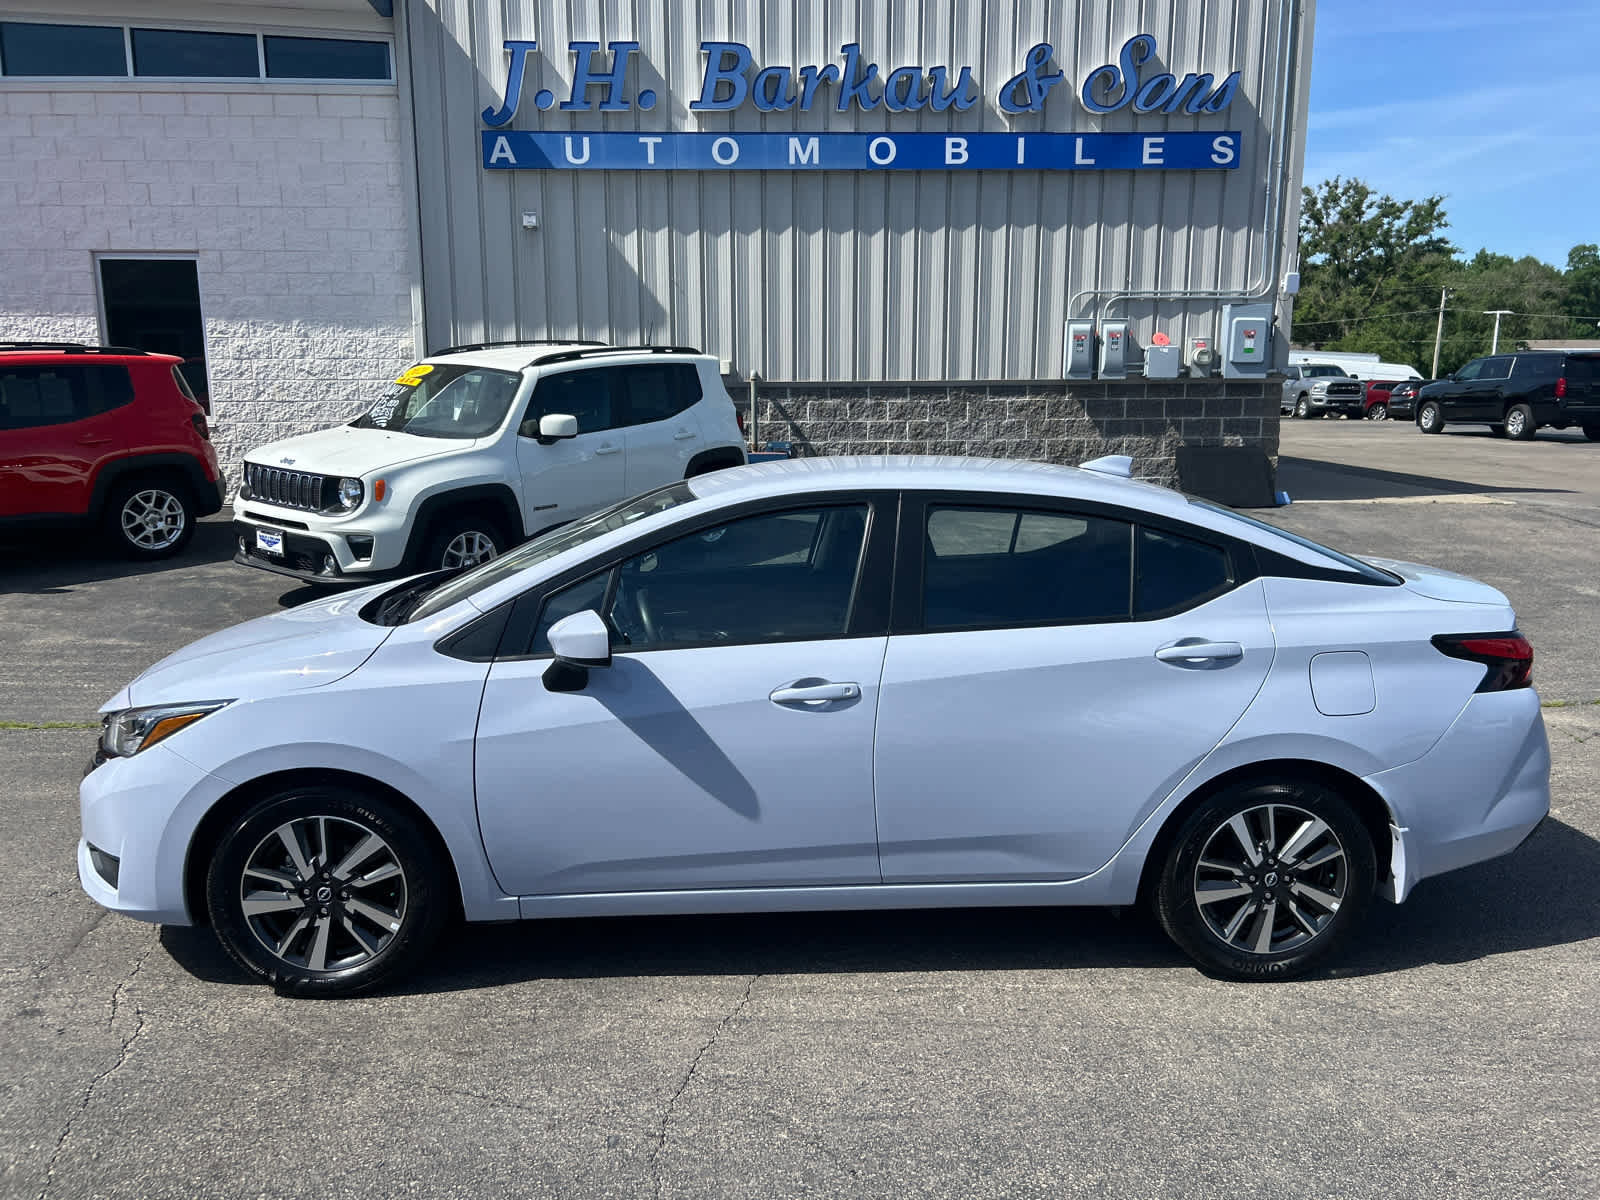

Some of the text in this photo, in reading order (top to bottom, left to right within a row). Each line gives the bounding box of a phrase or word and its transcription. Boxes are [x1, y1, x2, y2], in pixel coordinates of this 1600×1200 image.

[481, 33, 1241, 128] J.H. Barkau & Sons
[489, 135, 1235, 166] AUTOMOBILES
